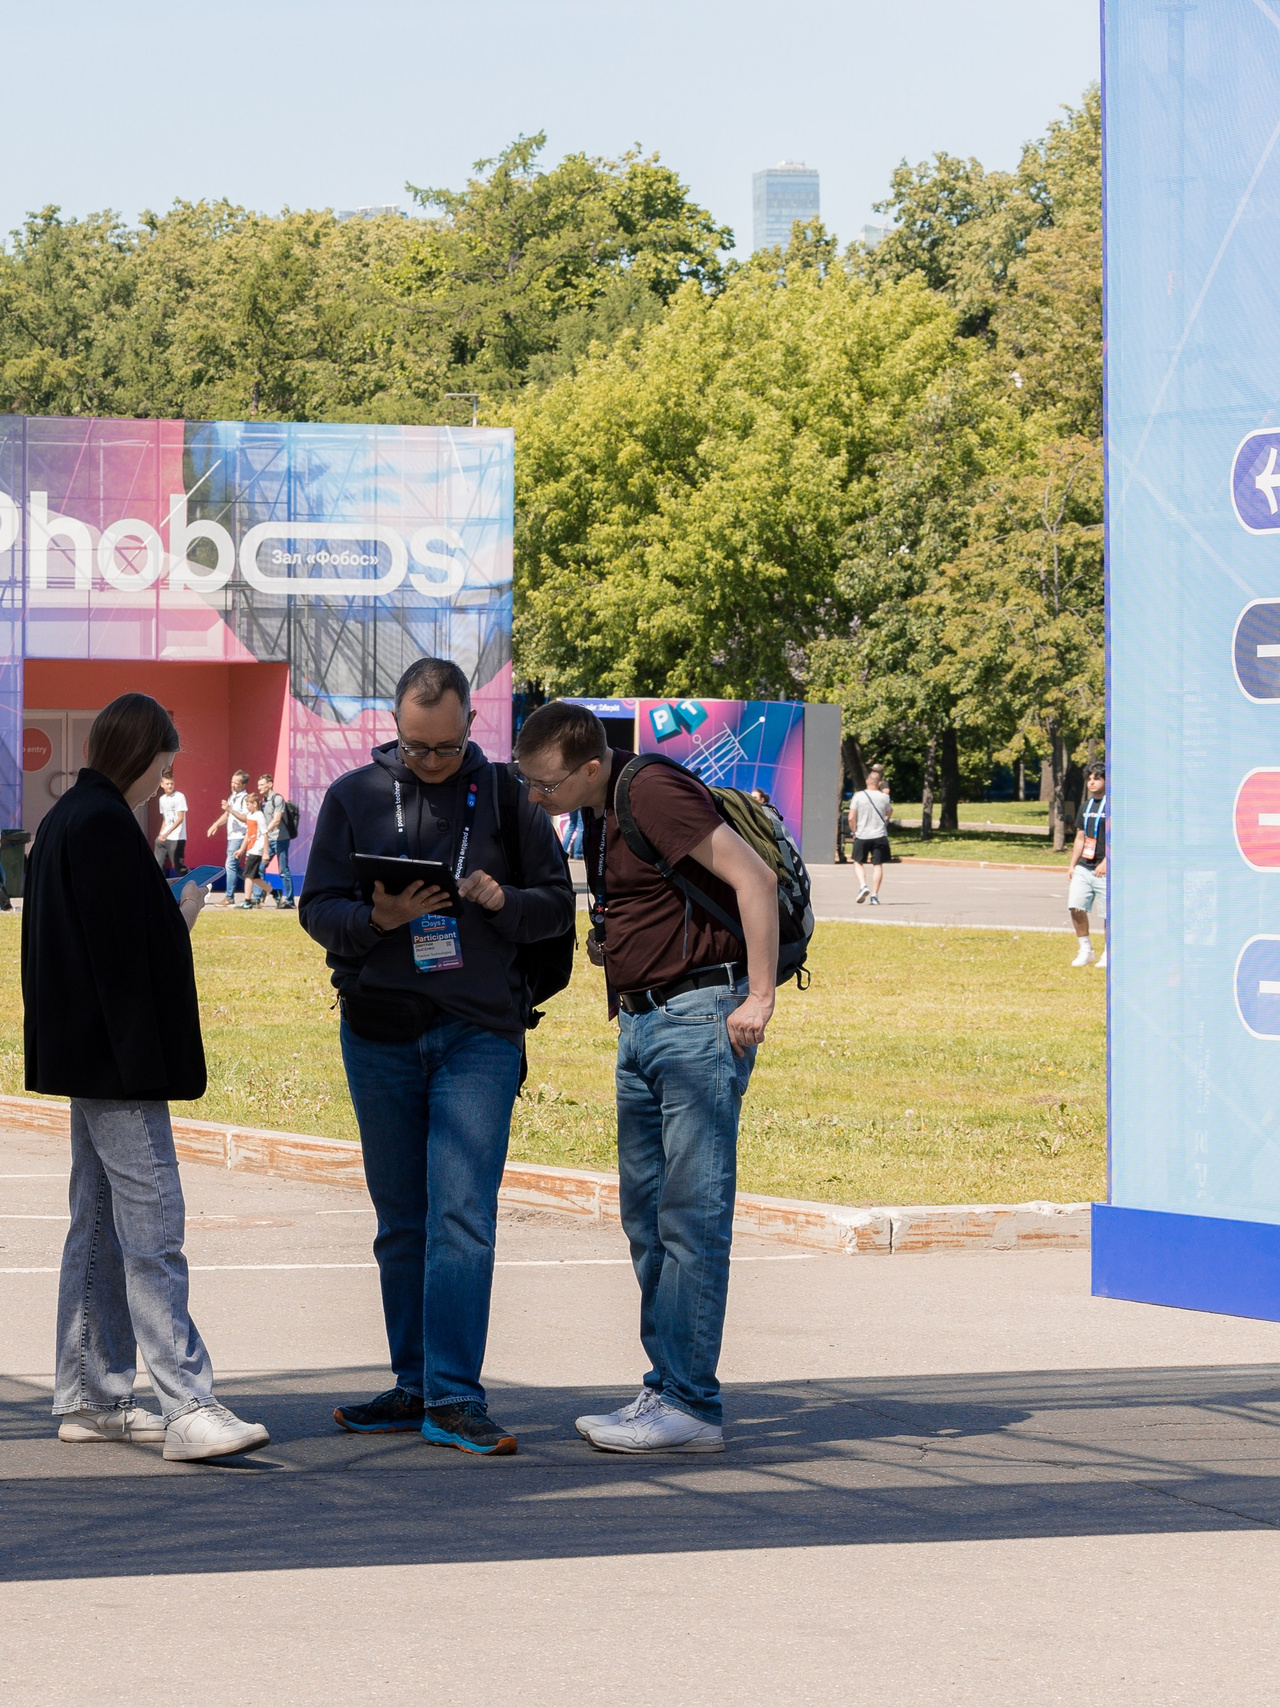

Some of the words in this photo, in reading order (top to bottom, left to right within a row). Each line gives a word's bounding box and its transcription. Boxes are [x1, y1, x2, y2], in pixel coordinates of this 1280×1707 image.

[271, 549, 302, 565] Зал
[306, 549, 380, 566] «Фобос»
[26, 746, 47, 755] entry
[459, 831, 469, 856] positive
[597, 853, 605, 876] Vision
[421, 919, 441, 928] Days
[413, 931, 457, 943] Participant
